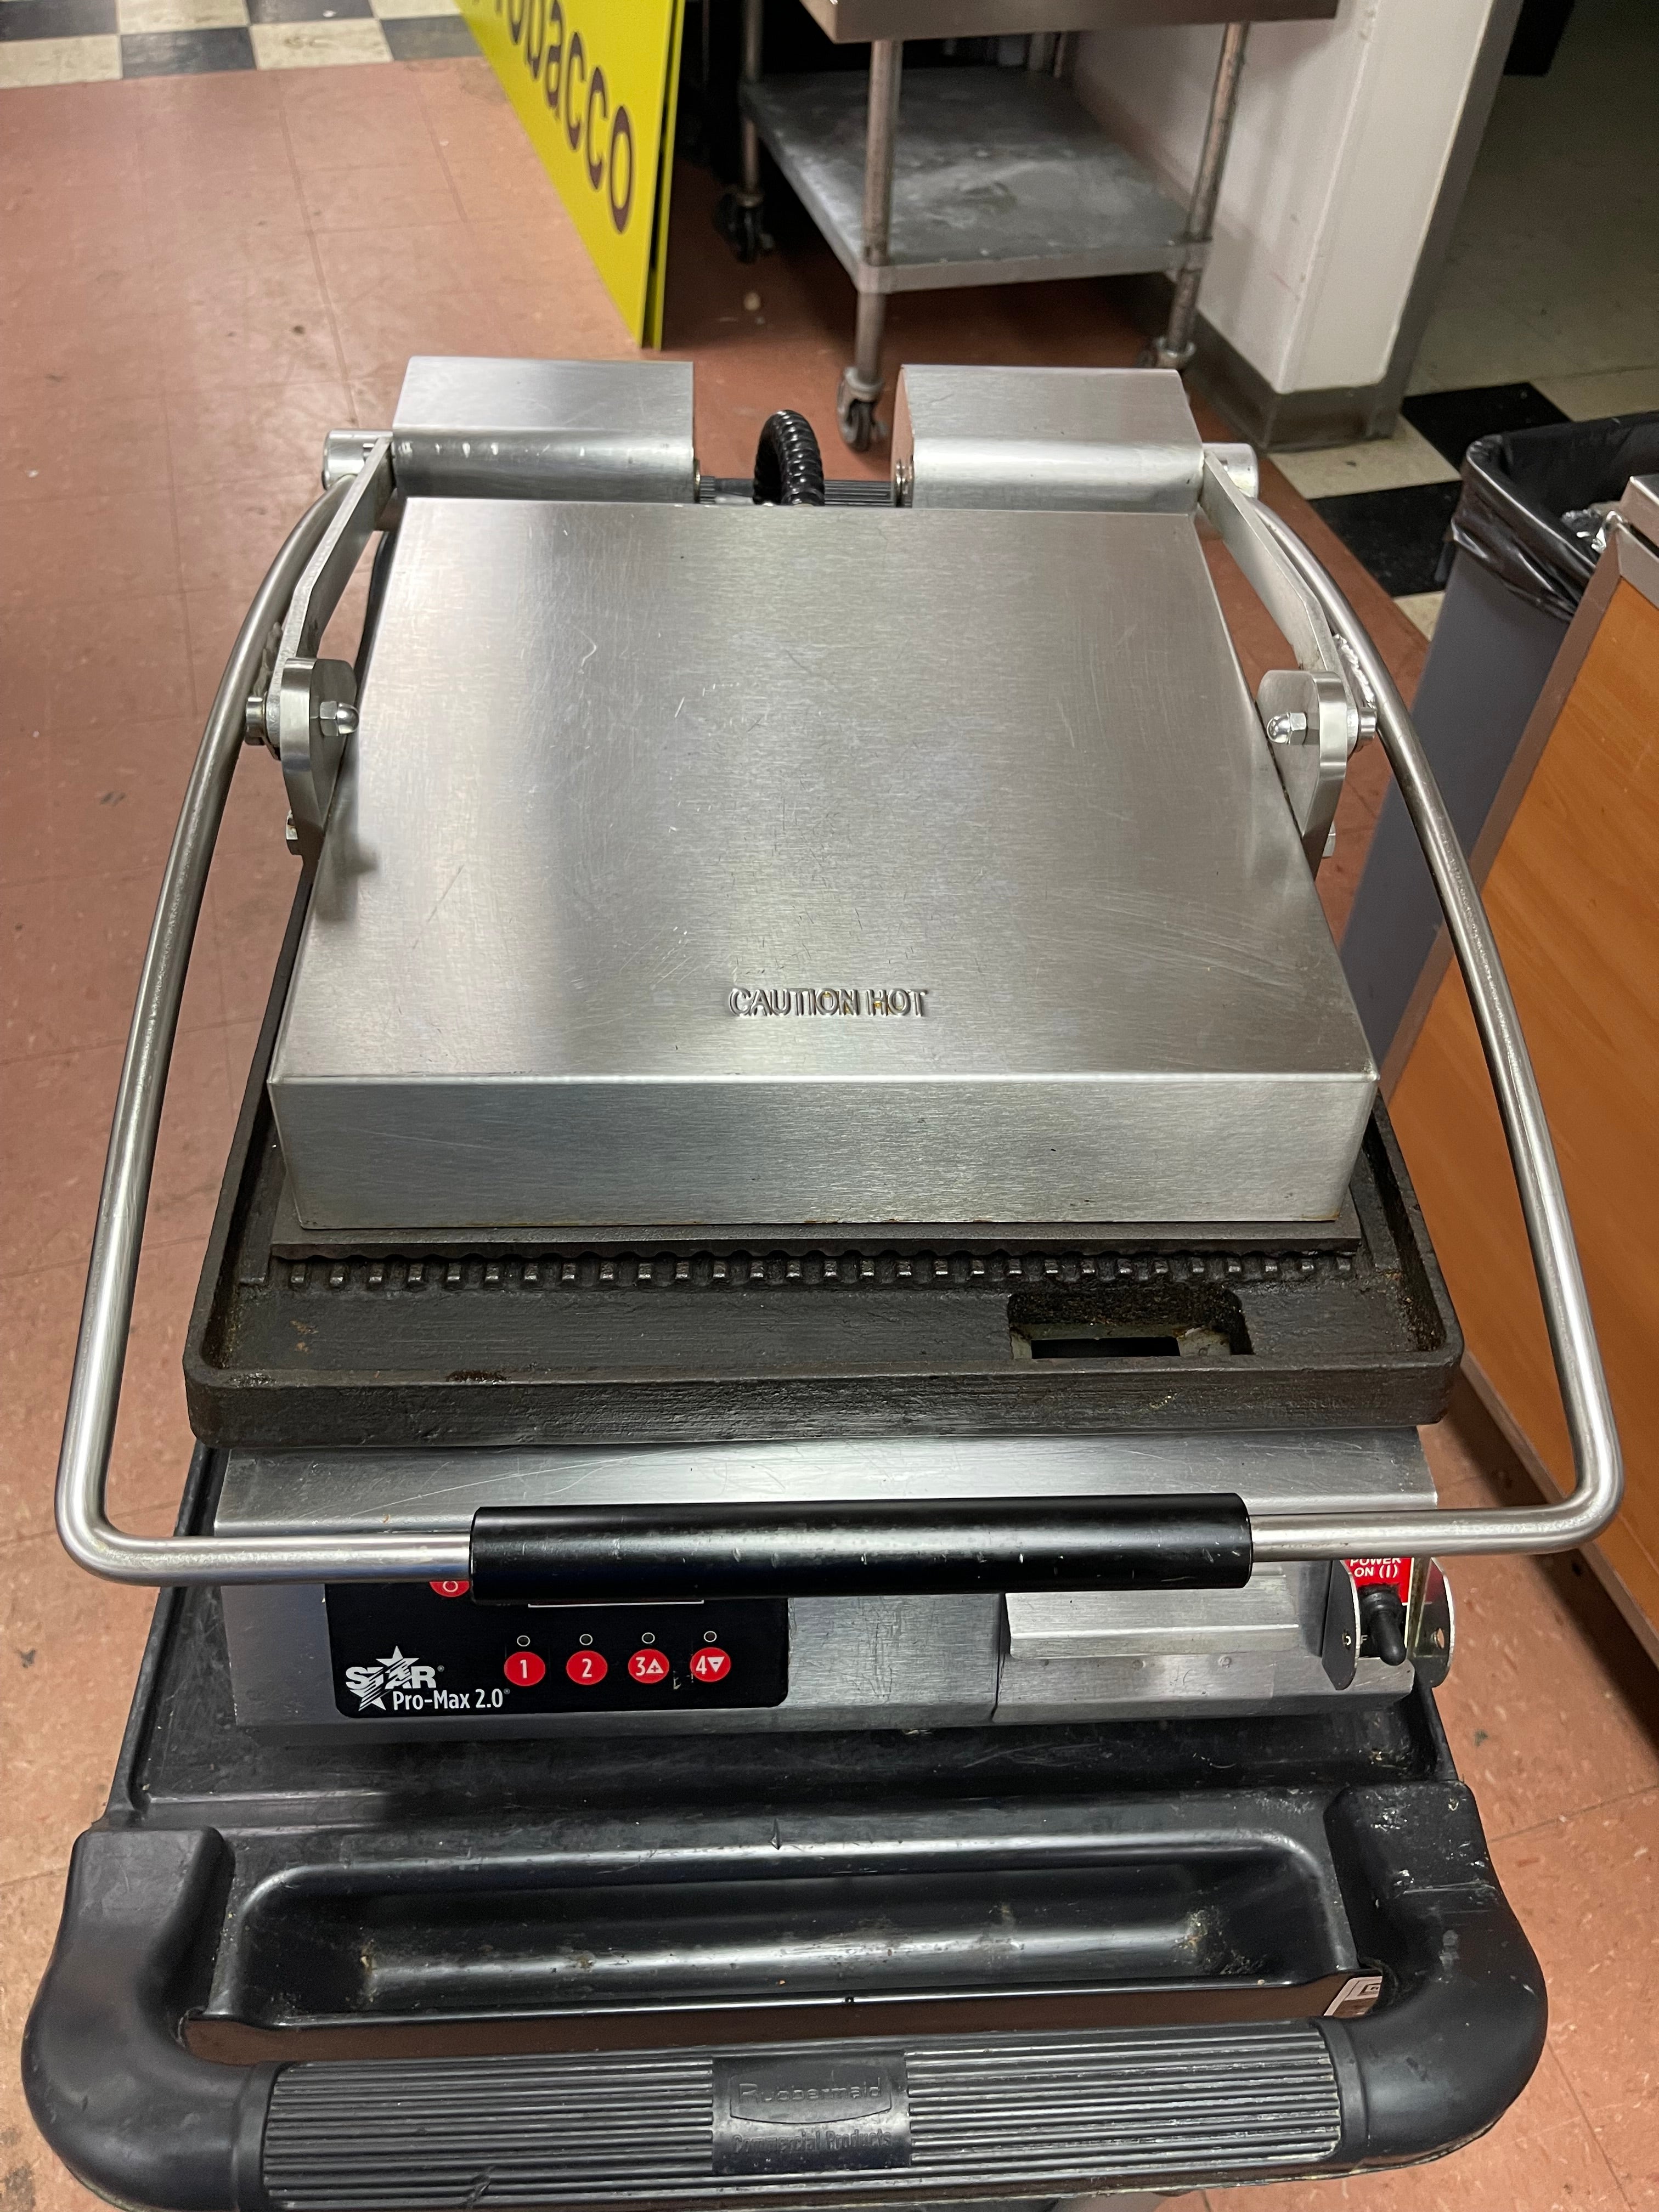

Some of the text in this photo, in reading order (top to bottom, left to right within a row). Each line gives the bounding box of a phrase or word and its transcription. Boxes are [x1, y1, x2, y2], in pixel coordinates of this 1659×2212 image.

[495, 0, 634, 235] bacco
[729, 988, 928, 1017] CAUTION HOT
[1350, 1558, 1402, 1567] POWER
[1354, 1567, 1374, 1577] ON
[520, 1659, 528, 1679] 1
[582, 1658, 592, 1678] 2
[635, 1657, 646, 1676] 3
[695, 1655, 707, 1674] 4
[345, 1665, 437, 1690] STAR
[392, 1688, 504, 1711] Pro-Max 2.0
[732, 2128, 892, 2153] Commercial Products
